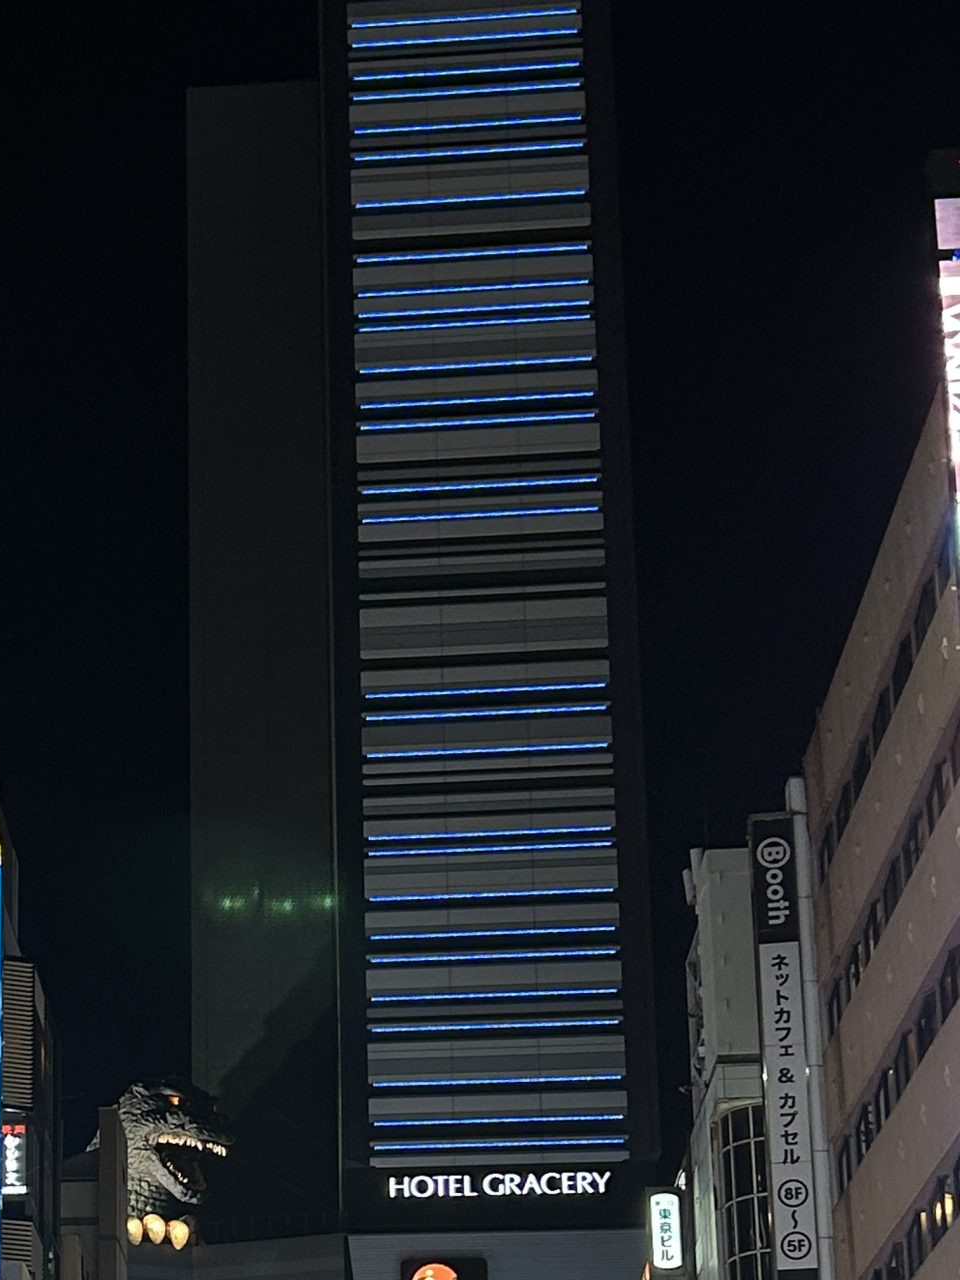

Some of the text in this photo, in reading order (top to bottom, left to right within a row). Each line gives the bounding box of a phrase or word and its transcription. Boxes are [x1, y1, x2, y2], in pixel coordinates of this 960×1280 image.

[756, 837, 791, 926] Booth
[771, 954, 801, 1166] ネットカフェ & カプセル
[389, 1171, 611, 1198] HOTEL GRACERY
[658, 1207, 675, 1262] 東京ビル
